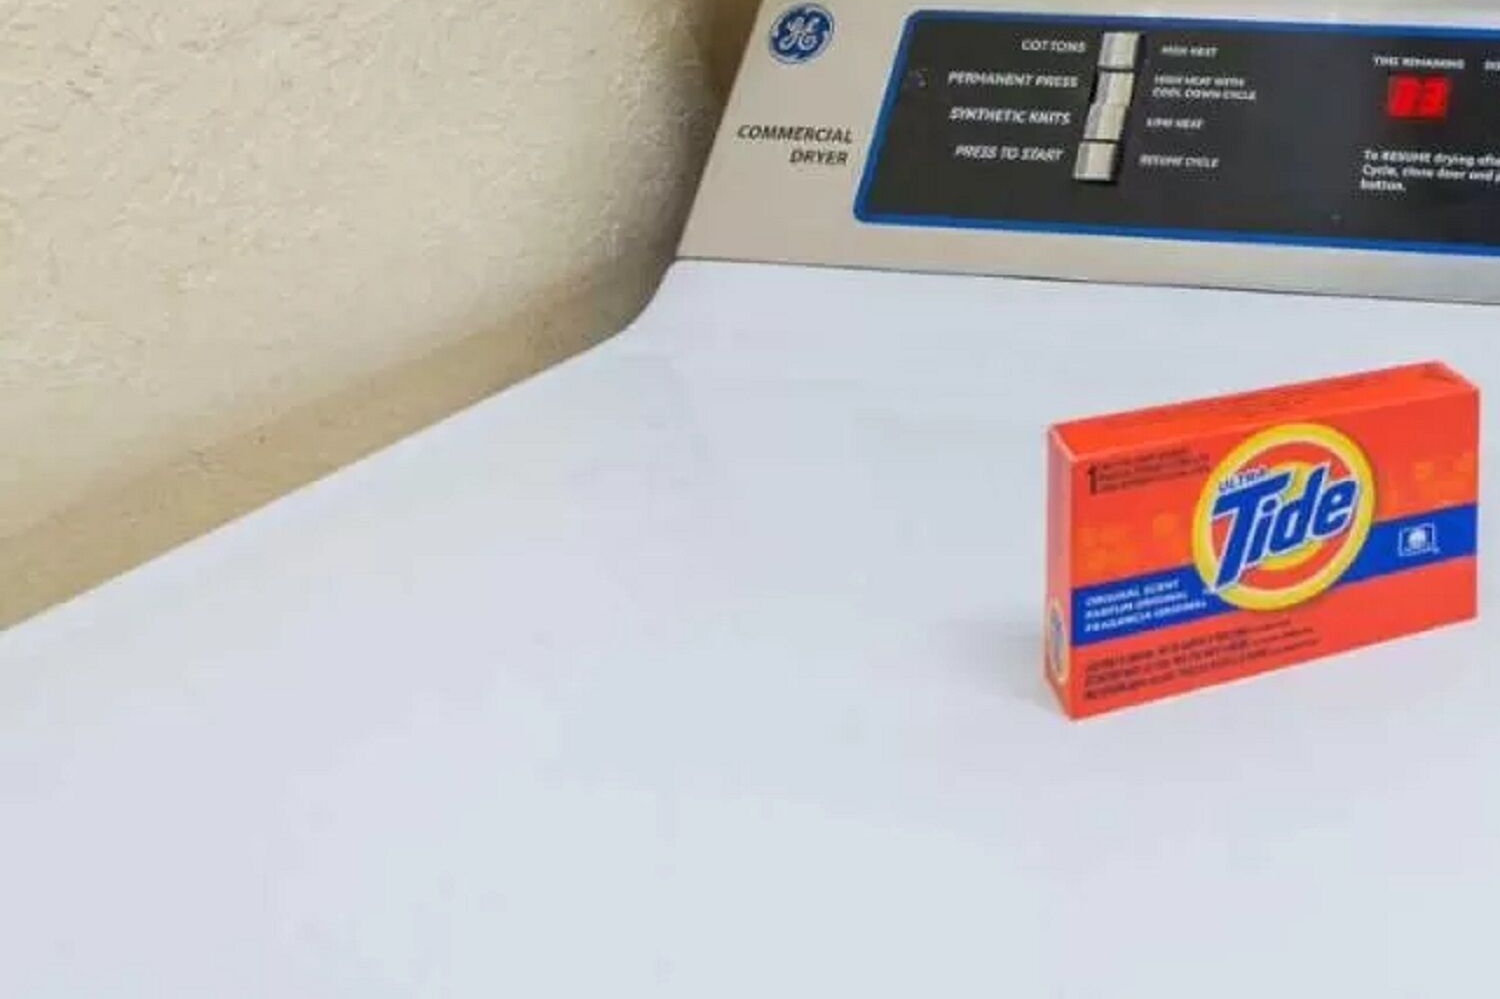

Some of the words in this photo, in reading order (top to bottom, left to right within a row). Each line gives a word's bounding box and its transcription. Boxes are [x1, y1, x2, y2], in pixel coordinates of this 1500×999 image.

[1021, 39, 1086, 53] COTTONS
[1189, 47, 1218, 58] HEAT
[1373, 55, 1399, 67] TIME
[1401, 56, 1465, 70] REMAINING
[948, 72, 1033, 88] PERMANENT
[1035, 75, 1079, 89] PRESS
[1152, 87, 1181, 98] COOL
[1184, 88, 1221, 99] DOWN
[1222, 89, 1257, 100] CYCLE
[949, 107, 1026, 123] SYNTHETIC
[1029, 111, 1071, 126] KNITS
[1174, 118, 1203, 129] HEAT
[737, 124, 853, 144] COMMERCIAL
[789, 148, 849, 166] DRYER
[954, 145, 997, 160] PRESS
[1000, 147, 1019, 160] TO
[1020, 147, 1064, 162] START
[1185, 156, 1220, 168] CYCLE
[1364, 150, 1379, 161] To
[1381, 151, 1431, 163] RESUME
[1434, 152, 1475, 167] drying
[1436, 168, 1466, 179] door
[1469, 169, 1494, 180] and
[1360, 179, 1407, 192] button.
[1087, 464, 1098, 495] 1
[1212, 466, 1357, 588] Tide
[1085, 588, 1140, 607] ORIGINAL
[1144, 579, 1179, 596] SCENT
[1085, 602, 1133, 619] PARFUM
[1135, 591, 1188, 609] ORIGINAL
[1153, 601, 1208, 619] ORIGINAL
